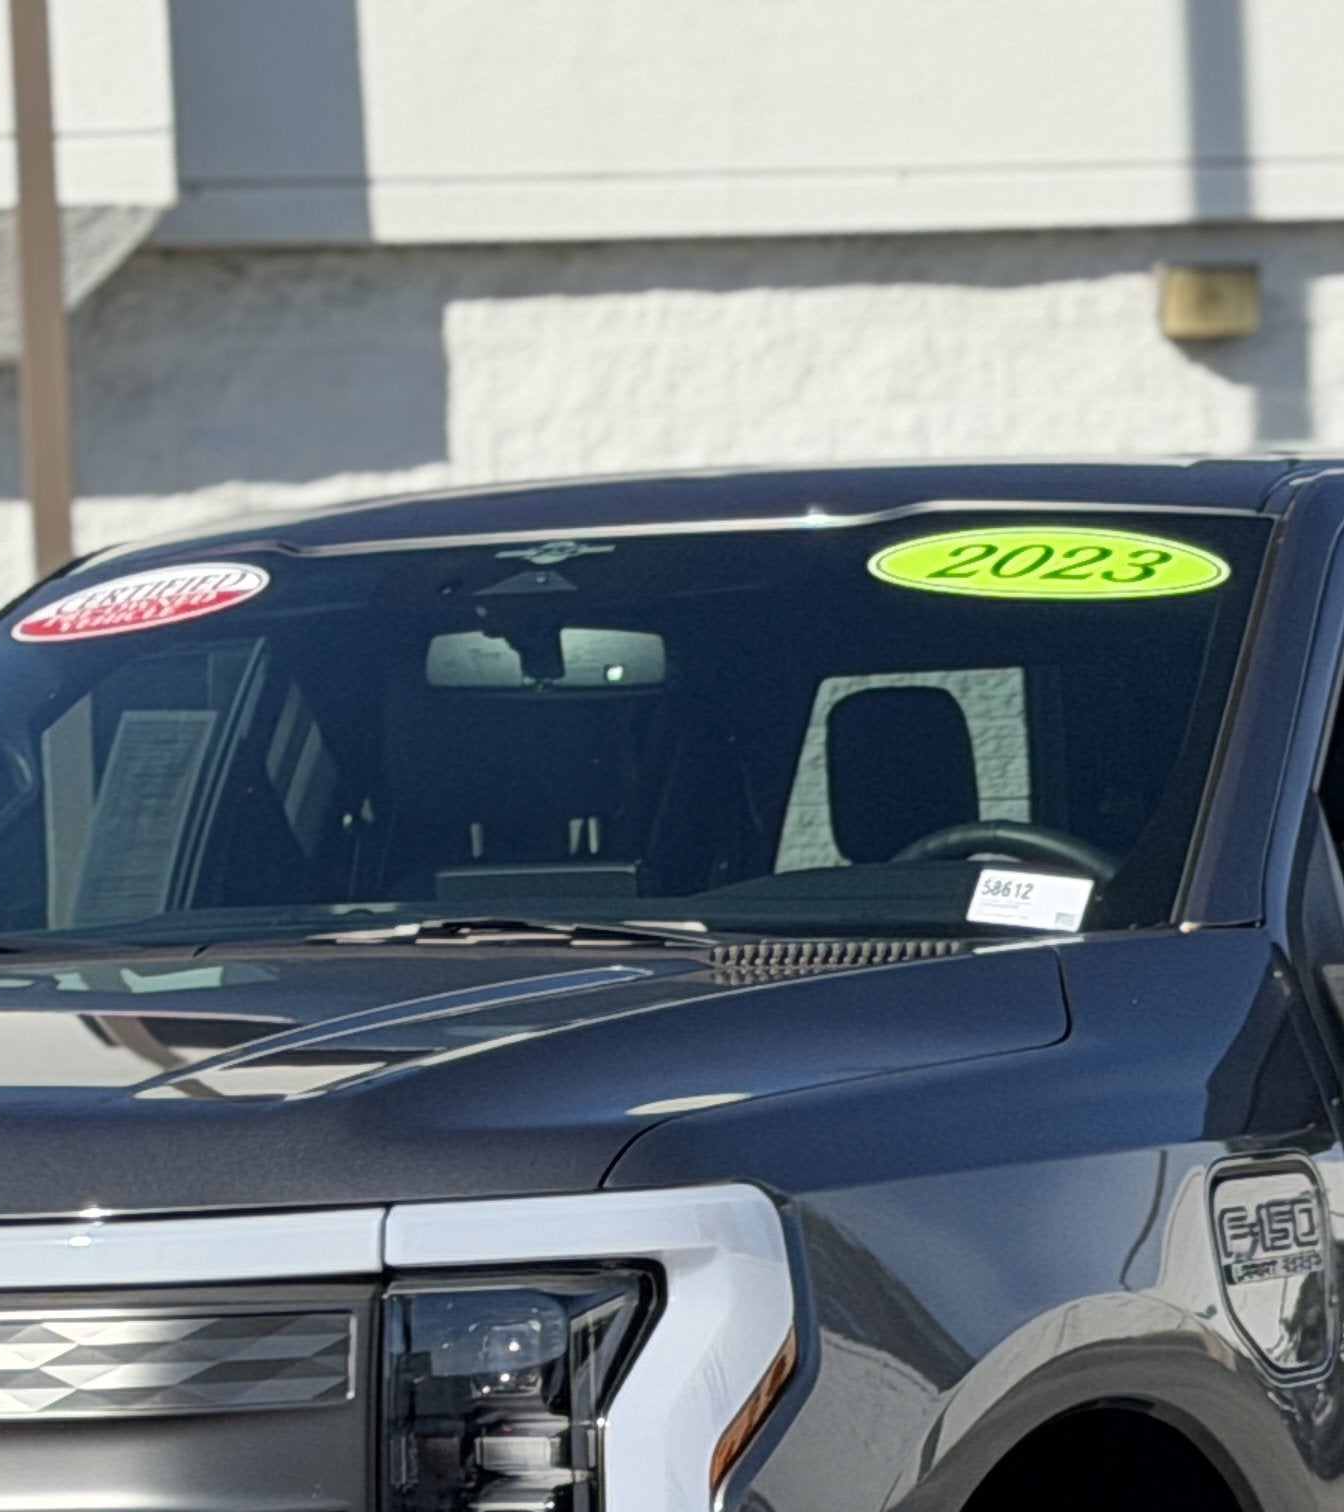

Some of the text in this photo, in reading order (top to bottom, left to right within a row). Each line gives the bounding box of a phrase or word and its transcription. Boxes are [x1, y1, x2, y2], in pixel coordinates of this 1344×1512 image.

[926, 544, 1173, 583] 2023
[57, 573, 247, 615] CERTIFIED
[981, 879, 1035, 900] 58612
[1218, 1198, 1320, 1258] F-150
